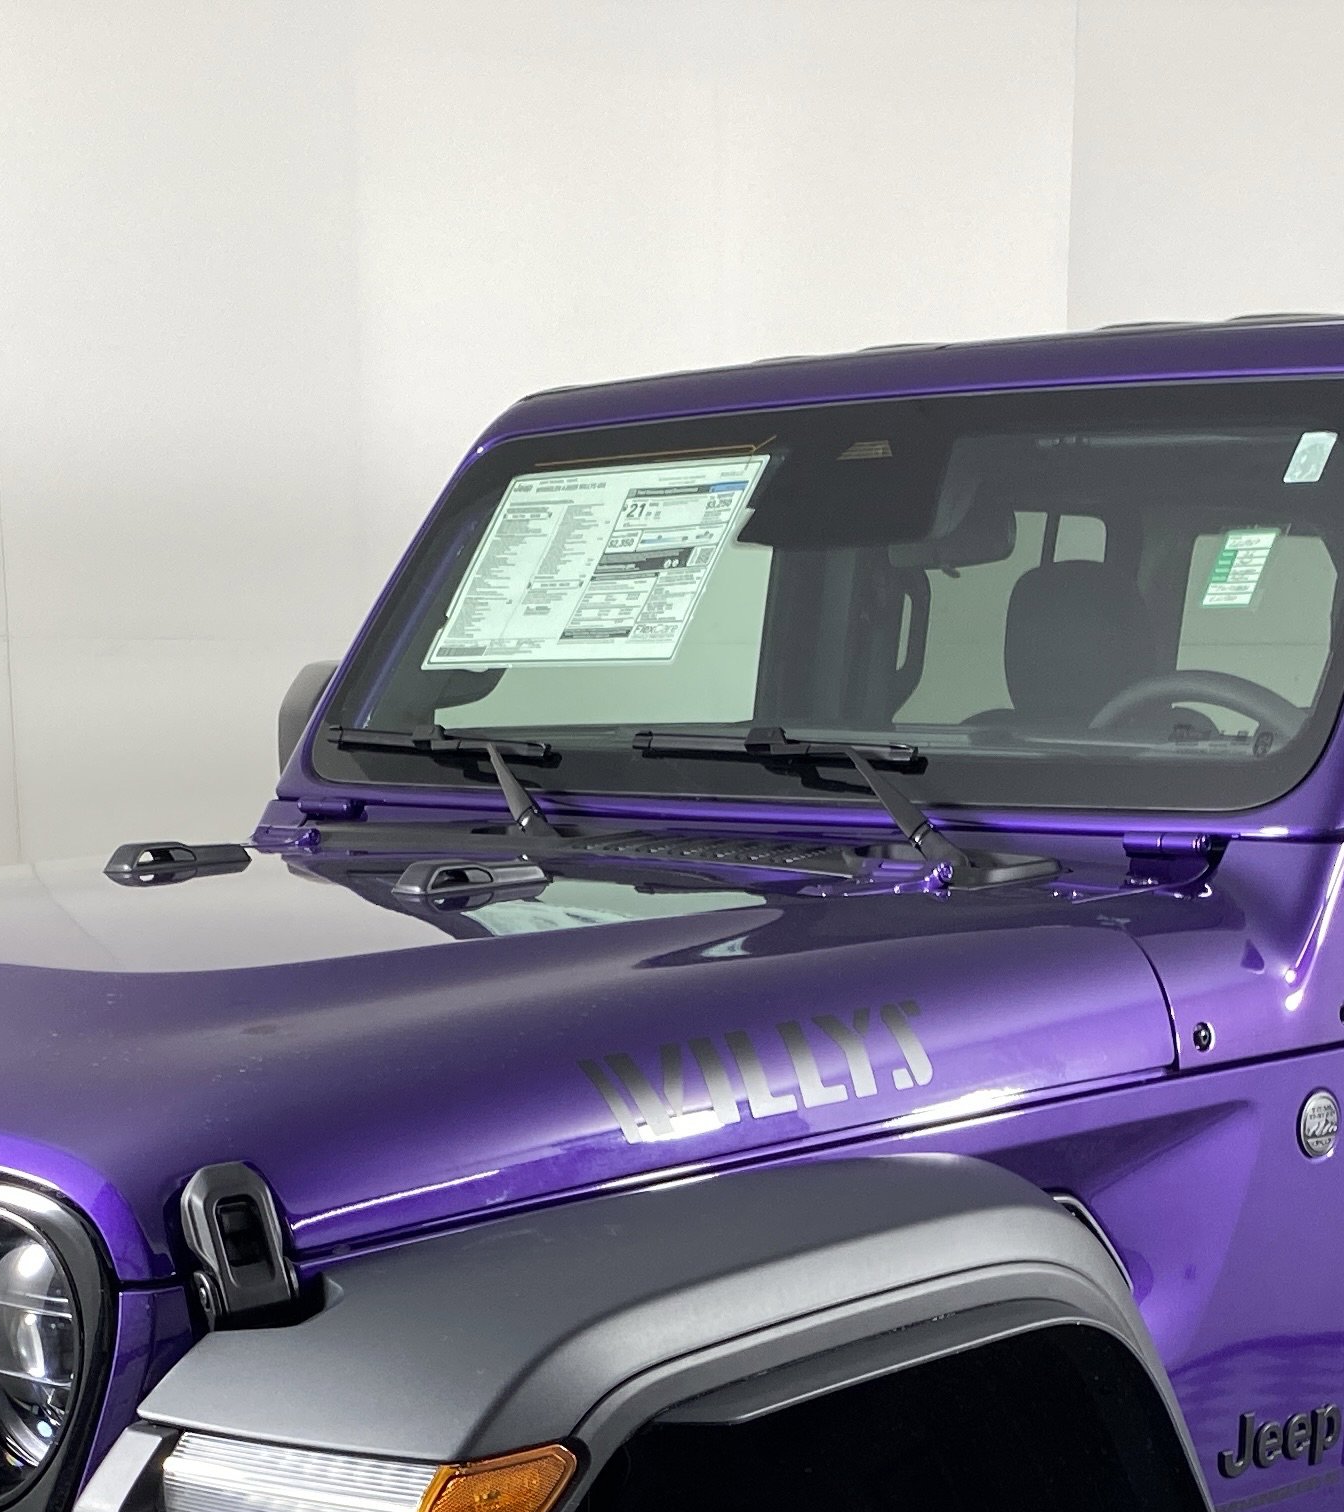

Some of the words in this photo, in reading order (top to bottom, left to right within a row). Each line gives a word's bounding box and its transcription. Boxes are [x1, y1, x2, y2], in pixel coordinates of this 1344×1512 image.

[626, 502, 647, 518] 21
[576, 1000, 934, 1145] WILLYS
[1217, 1403, 1342, 1479] Jeep
